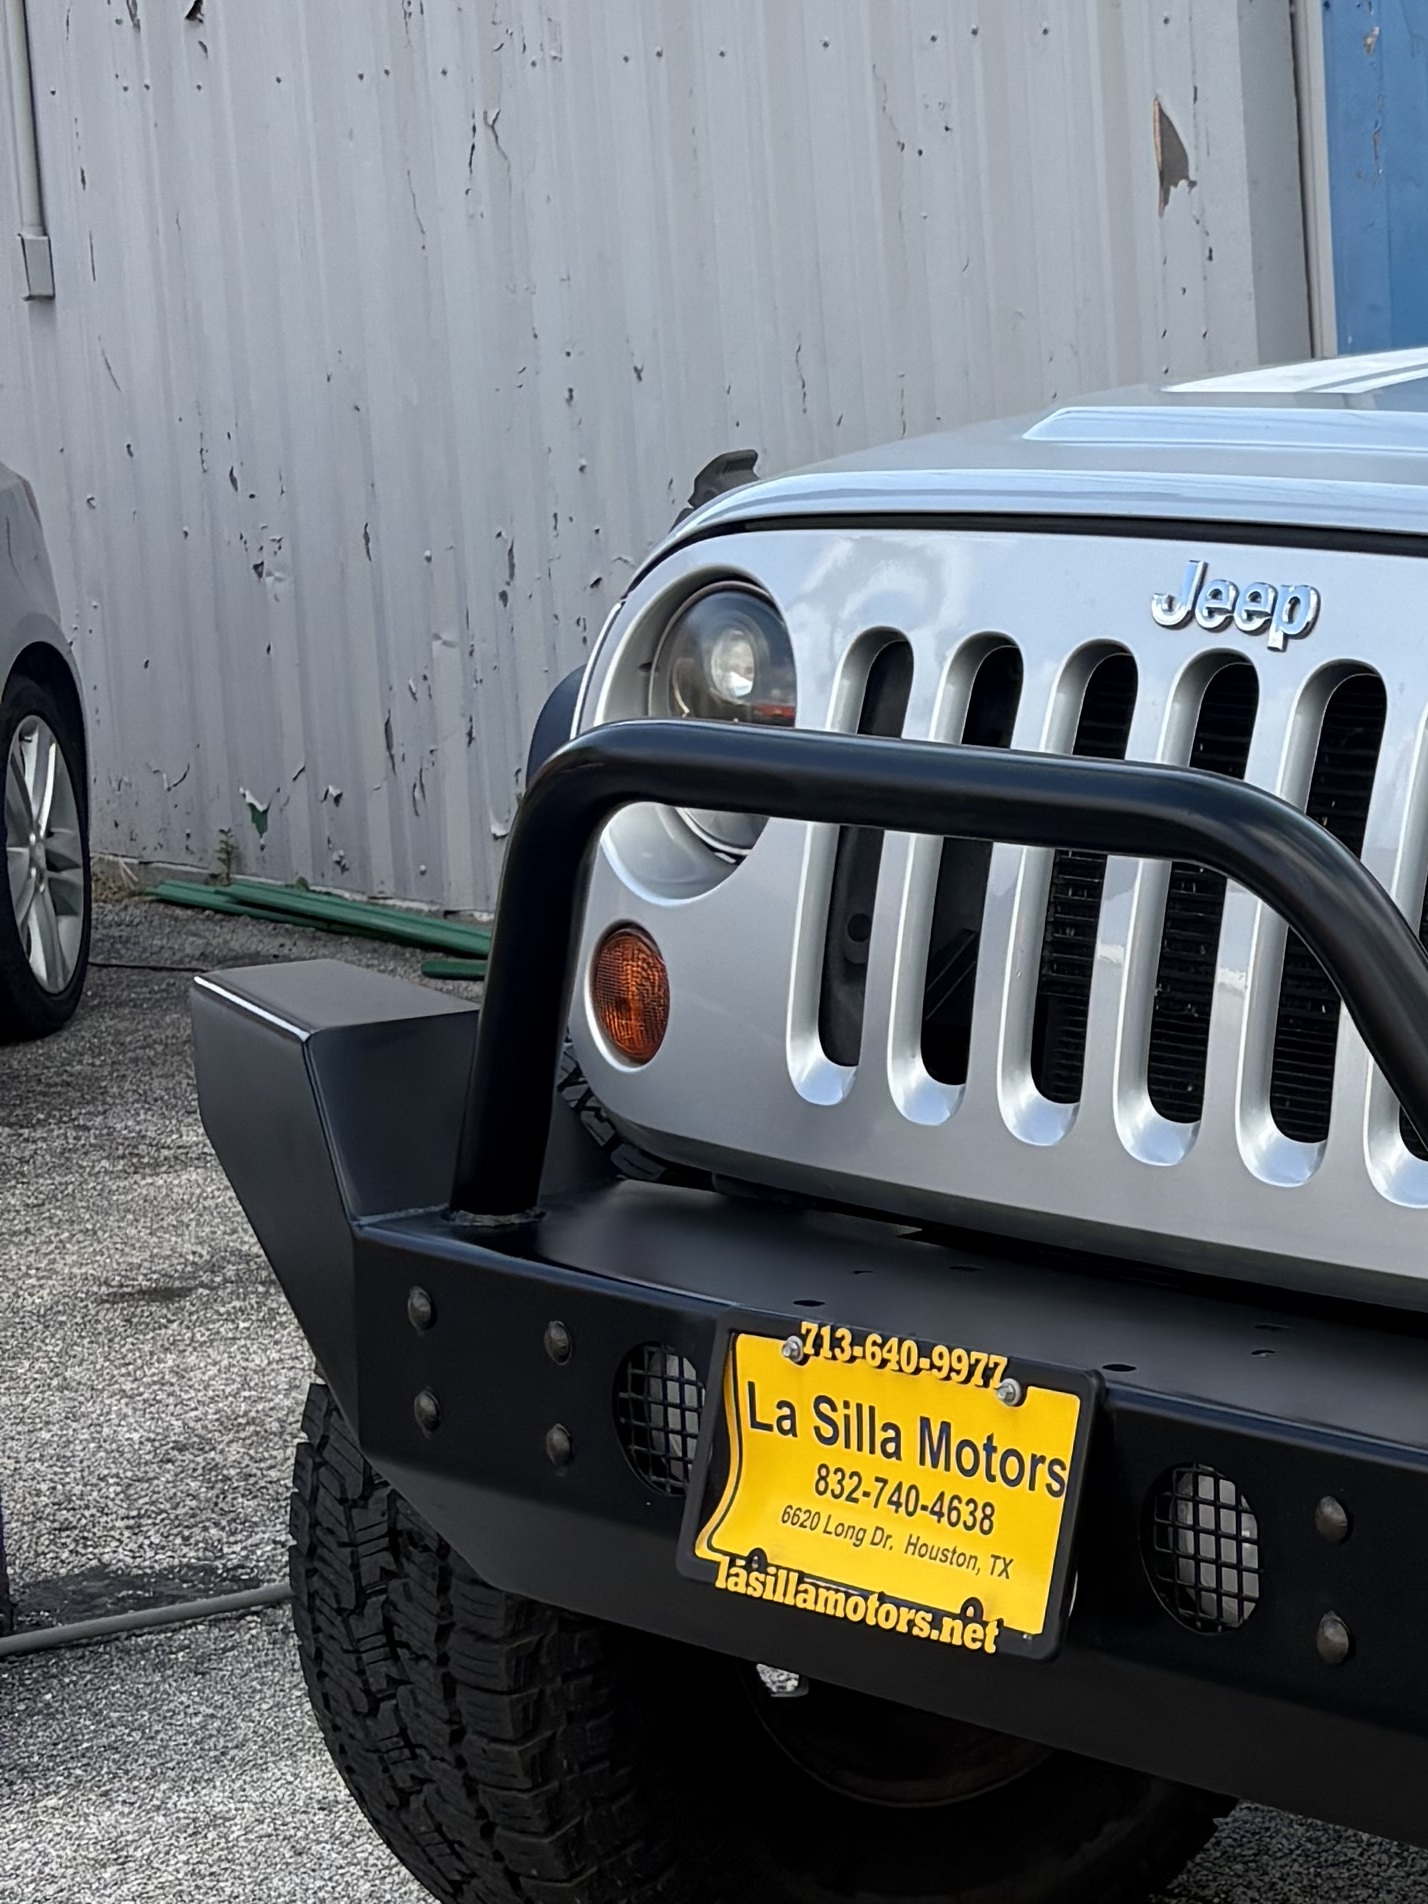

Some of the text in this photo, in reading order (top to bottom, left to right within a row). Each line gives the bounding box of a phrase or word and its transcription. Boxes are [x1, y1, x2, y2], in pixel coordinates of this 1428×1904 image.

[1151, 559, 1321, 652] Jeep
[800, 1322, 1009, 1388] 713-640-9977
[746, 1379, 1067, 1499] La Silla Motors
[814, 1462, 996, 1536] 832-740-4638
[781, 1504, 1014, 1580] 6620 Long Dr. Houston, TX
[714, 1553, 999, 1655] lasillamotors.net
